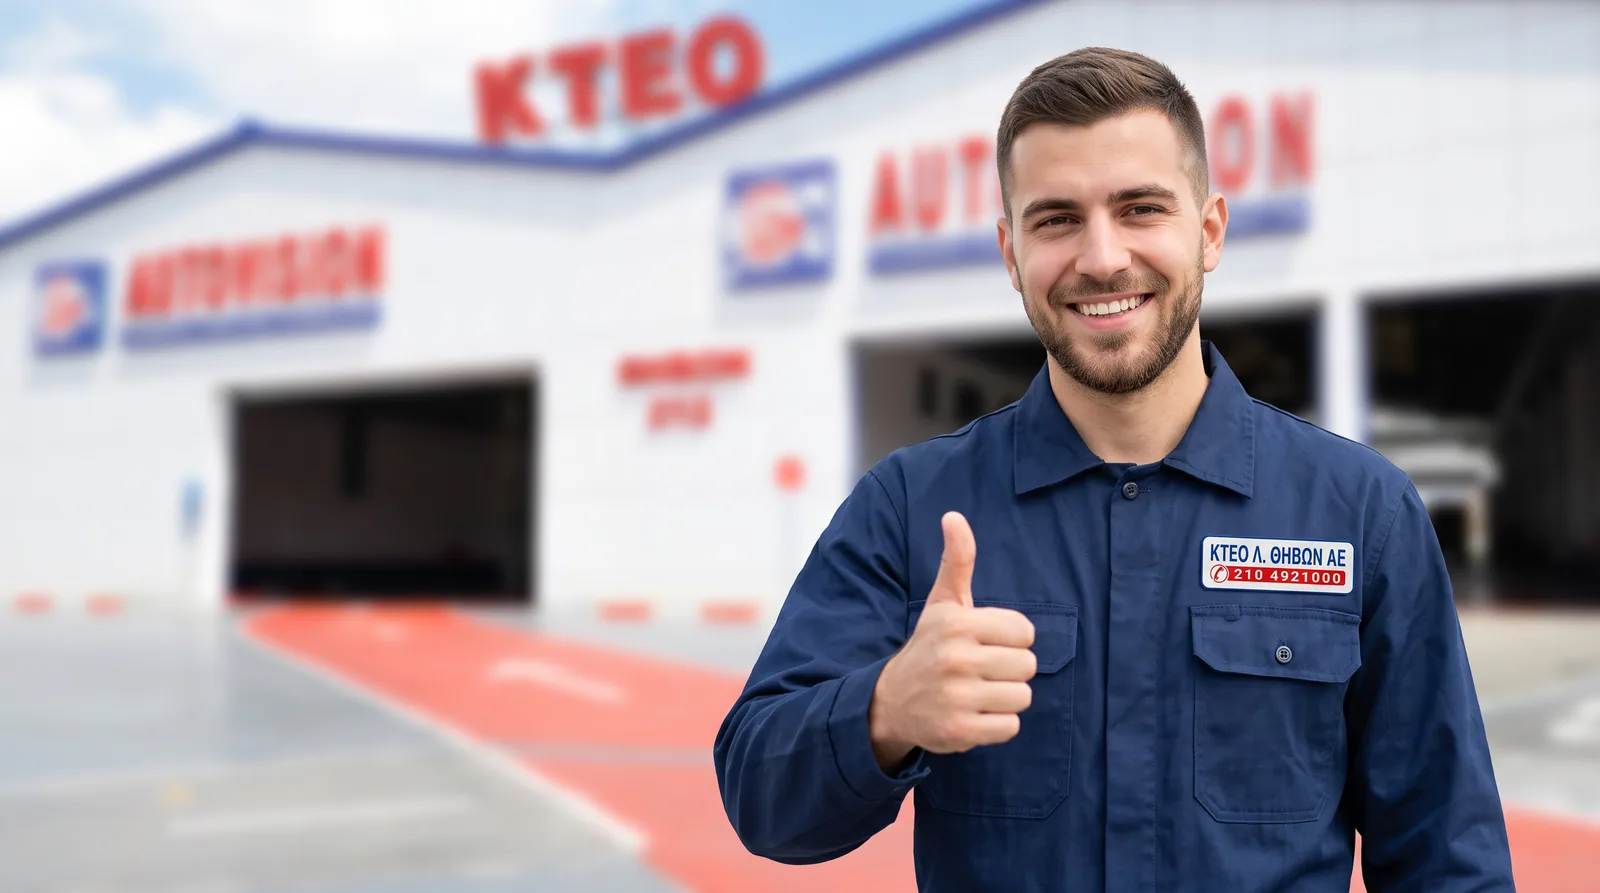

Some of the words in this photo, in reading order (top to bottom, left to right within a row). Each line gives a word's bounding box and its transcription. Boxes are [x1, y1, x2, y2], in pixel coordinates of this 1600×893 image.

[473, 16, 765, 145] ΚΤΕΟ
[1210, 543, 1248, 563] ΚΤΕΟ
[1252, 545, 1266, 564] Λ.
[1270, 546, 1322, 566] ΘΗΒΩΝ
[1327, 549, 1346, 567] ΑΕ
[1234, 568, 1263, 581] 210
[1270, 570, 1341, 584] 4921000
